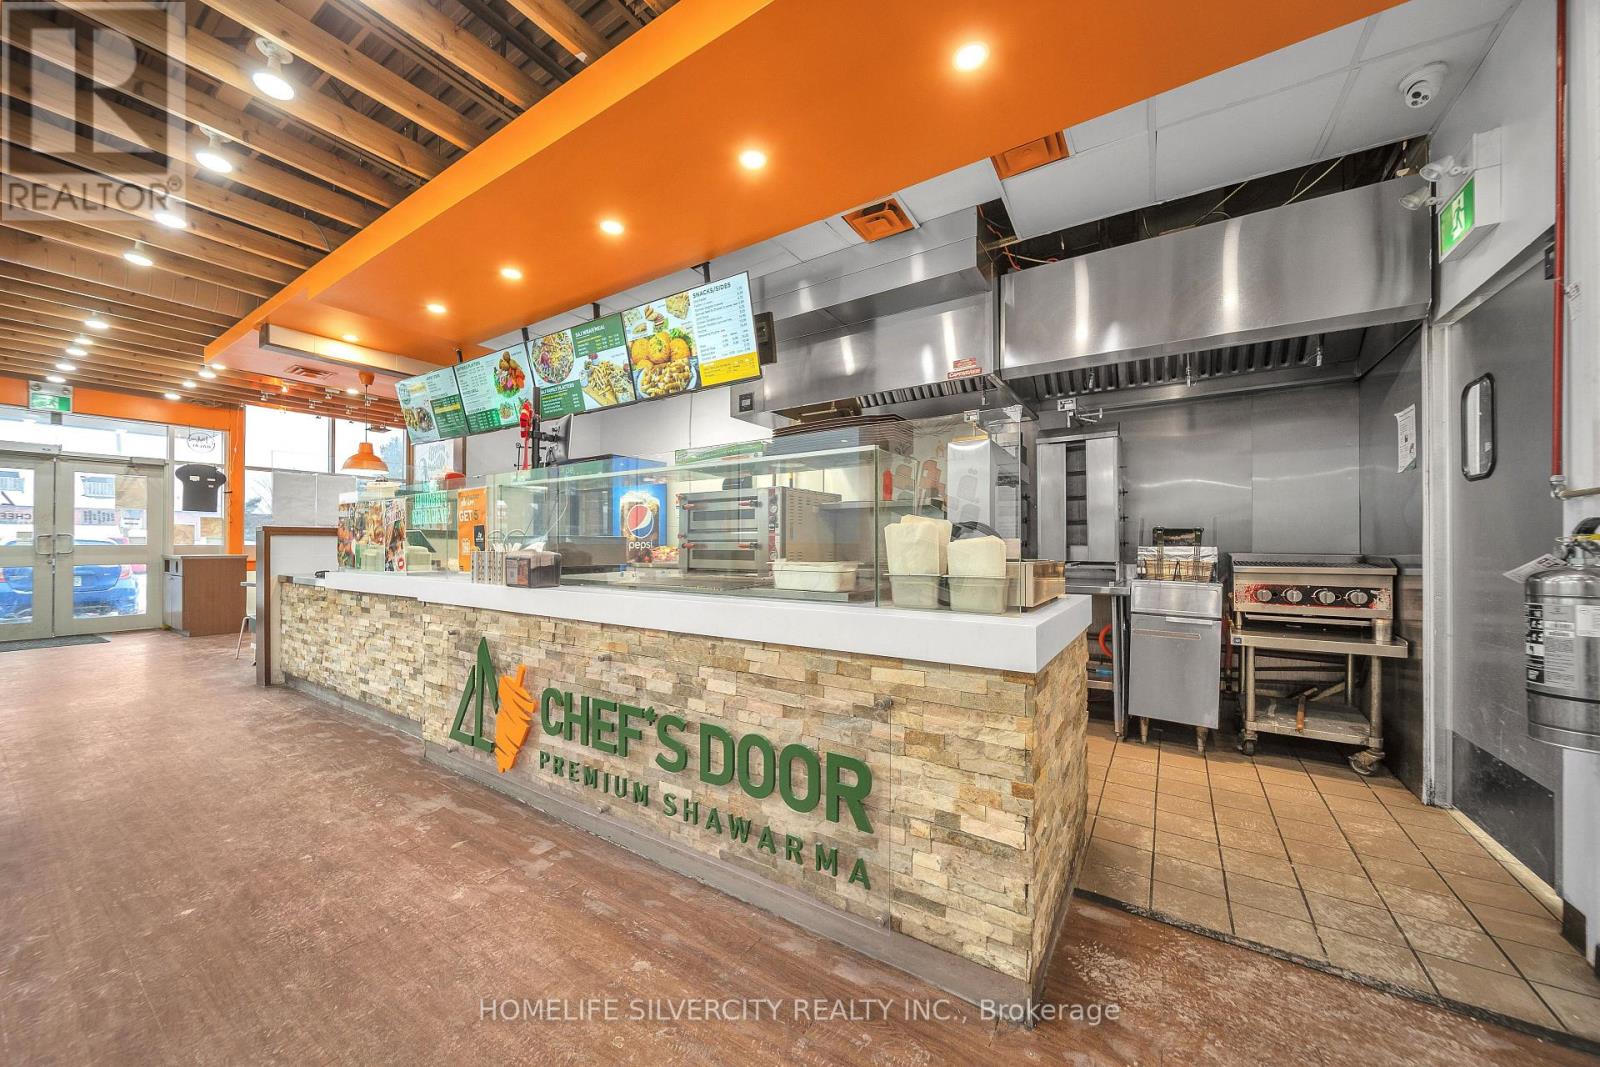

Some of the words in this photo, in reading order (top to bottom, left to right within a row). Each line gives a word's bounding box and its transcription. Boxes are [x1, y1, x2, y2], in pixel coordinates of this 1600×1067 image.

[692, 282, 731, 298] SNACKS/SIDES
[628, 540, 653, 551] pepsi
[540, 686, 689, 773] CHEF'S
[699, 722, 873, 834] DOOR
[538, 749, 649, 807] PREMIUM
[662, 792, 871, 890] SHAWARMA
